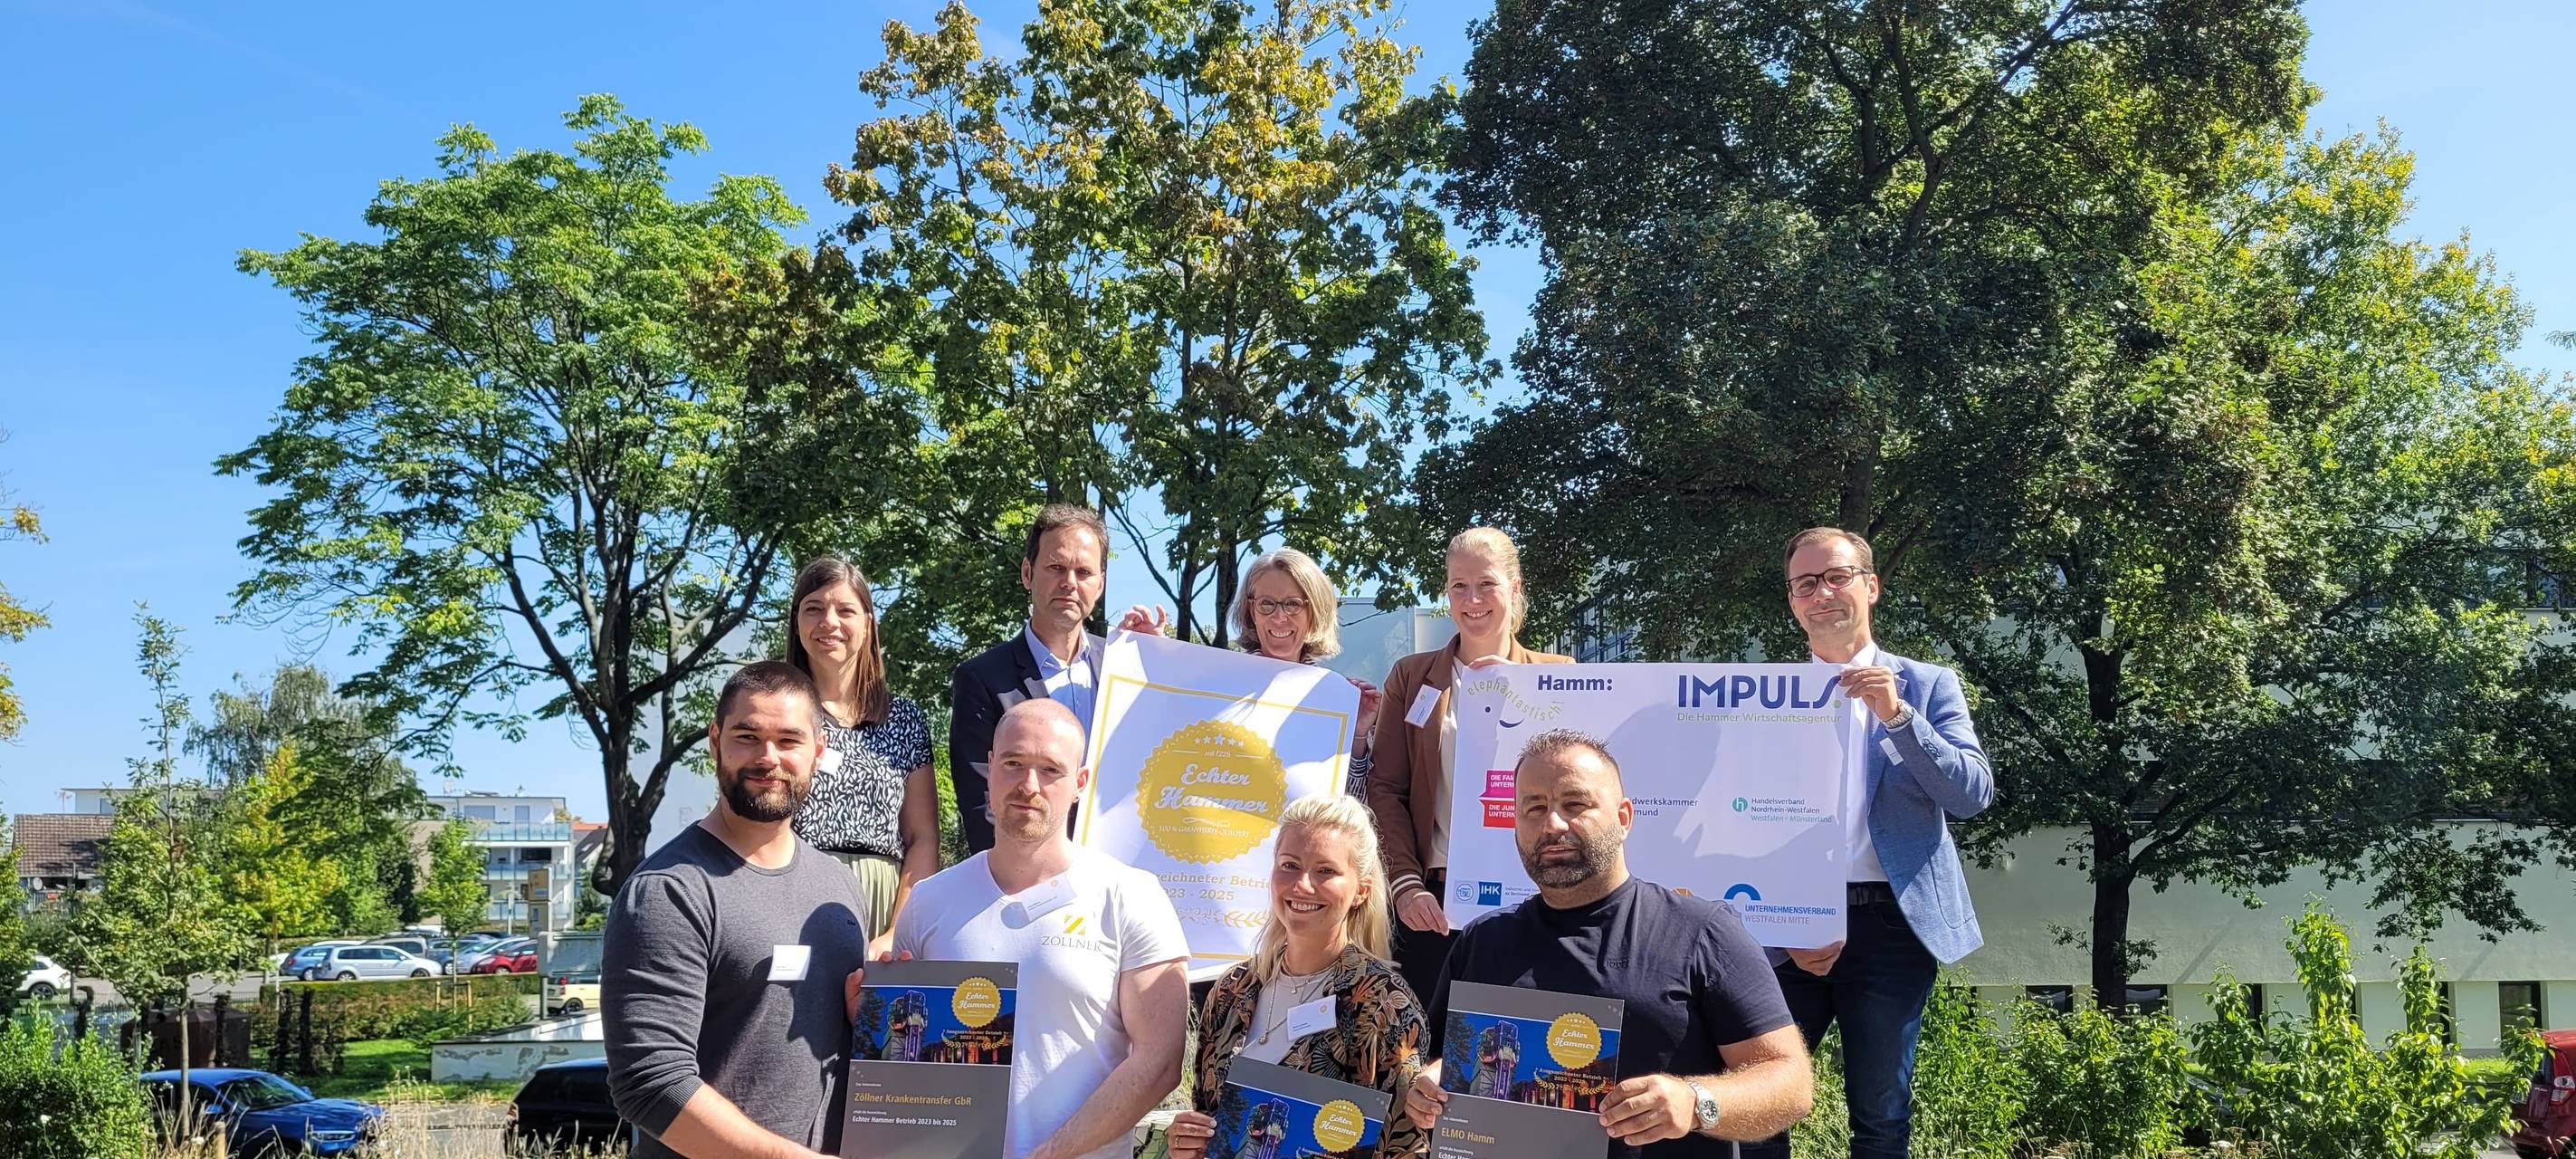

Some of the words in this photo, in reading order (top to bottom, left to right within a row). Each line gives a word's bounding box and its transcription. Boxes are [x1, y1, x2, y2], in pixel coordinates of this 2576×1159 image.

[1538, 675, 1613, 691] Hamm:
[1677, 713, 1693, 722] Die
[1697, 713, 1739, 722] Hammer
[1742, 714, 1842, 724] Wirtschaftsagentur
[1181, 763, 1251, 785] Echter
[1154, 786, 1268, 812] Hammer
[1630, 797, 1699, 807] dwerkskammer
[1751, 806, 1820, 814] Nordrhein-Westfalen
[1199, 889, 1236, 901] 2025
[1481, 885, 1500, 896] IHK
[1745, 905, 1837, 915] UNTERNEHMENSVERBAND
[1745, 915, 1787, 924] WESTFALEN
[1789, 916, 1810, 924] MITTE
[1042, 935, 1102, 952] ZÖLLNER
[966, 991, 989, 1001] Echter
[958, 1000, 995, 1009] Hammer
[1562, 1029, 1589, 1039] Echter
[1553, 1037, 1596, 1049] Hammer
[854, 1093, 883, 1102] Zöllner
[886, 1094, 951, 1105] Krankentransfer
[955, 1097, 971, 1106] GbR
[1330, 1114, 1353, 1125] Echter
[1319, 1121, 1357, 1136] Hammer
[1441, 1127, 1465, 1139] ELMO
[1467, 1132, 1494, 1145] Hamm
